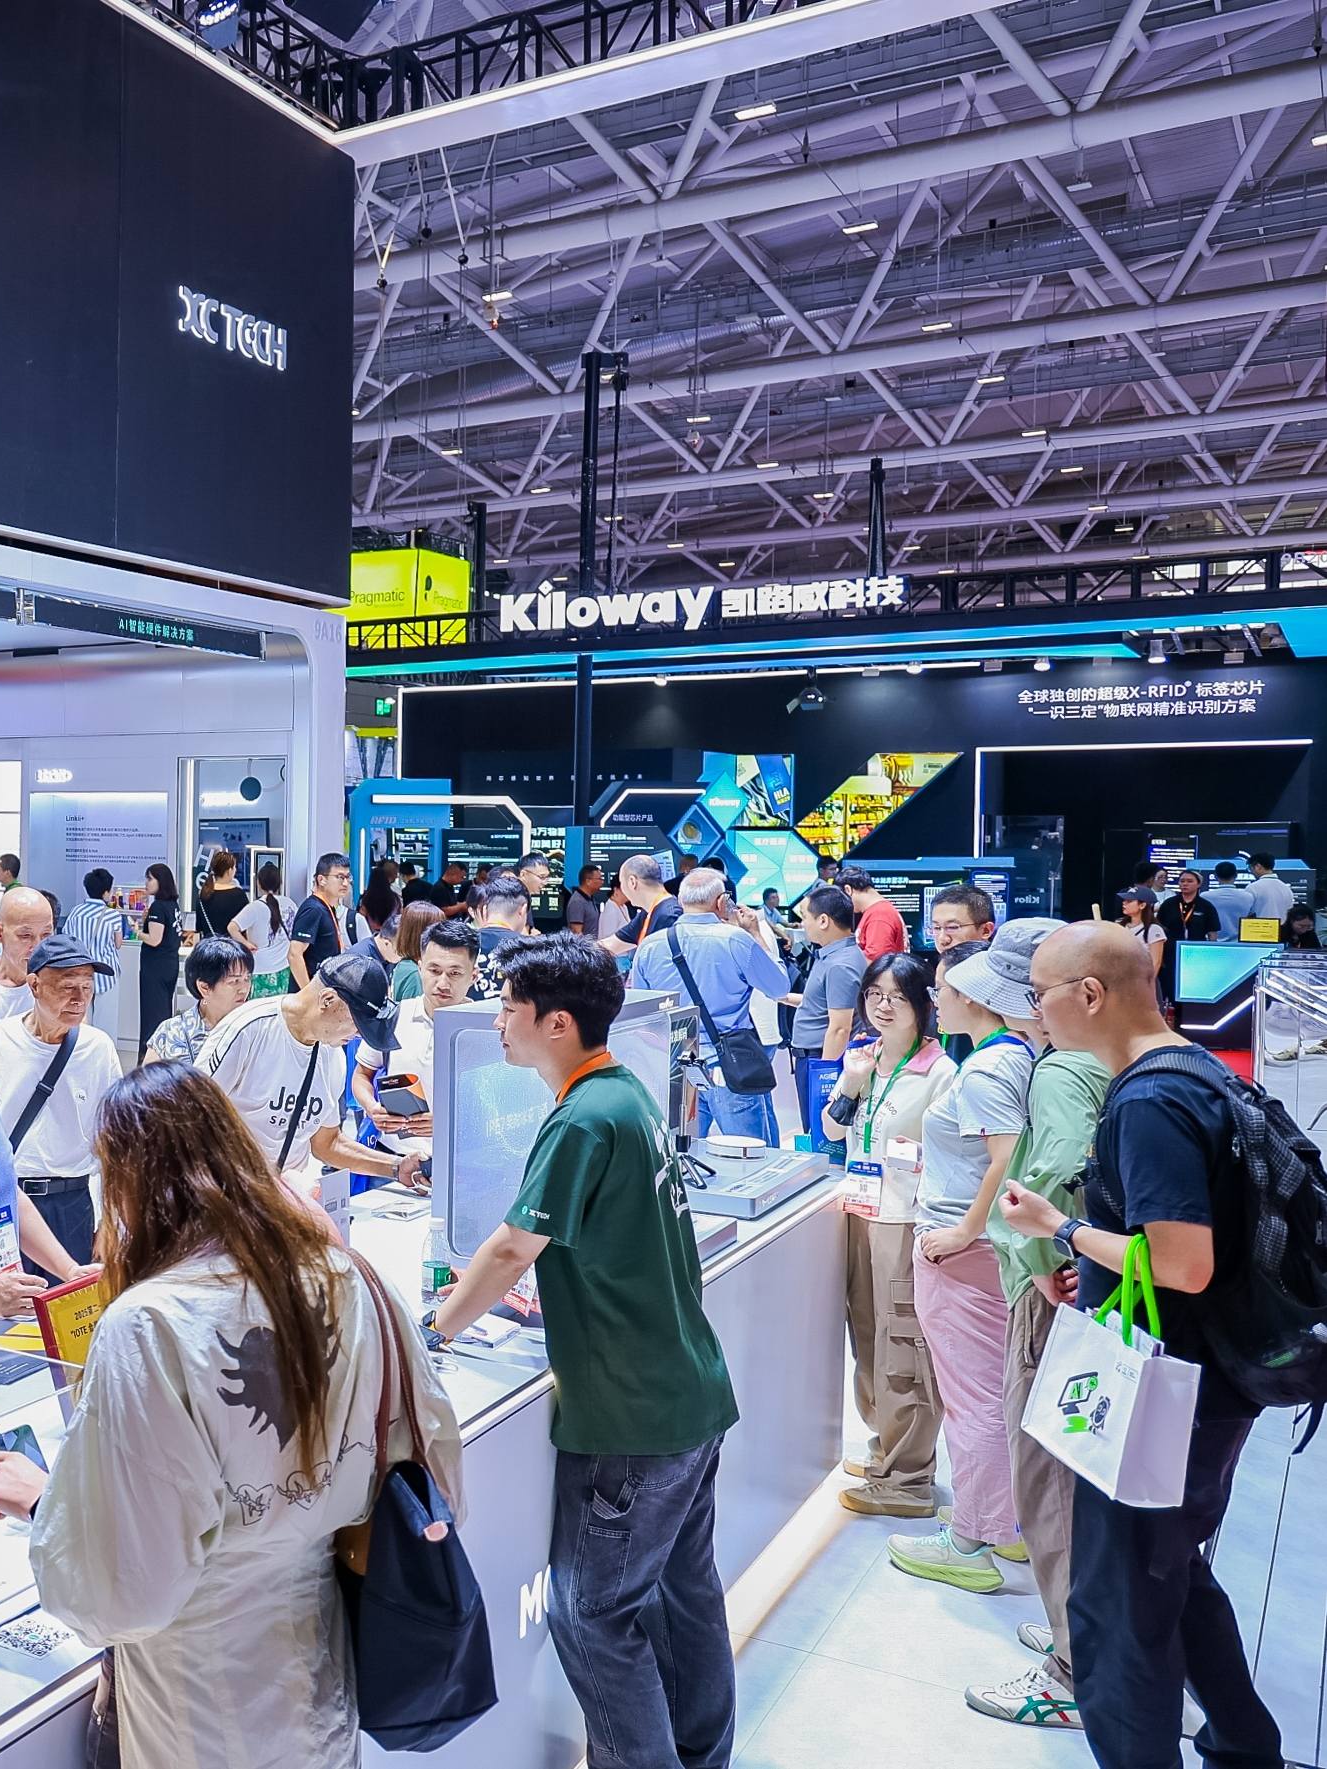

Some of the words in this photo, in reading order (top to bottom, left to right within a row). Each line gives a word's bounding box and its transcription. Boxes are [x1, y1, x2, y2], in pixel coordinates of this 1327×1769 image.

[178, 285, 219, 344] XC
[220, 303, 288, 371] TECH
[350, 589, 406, 606] Pragmatic
[499, 579, 715, 632] Kiloway
[720, 575, 906, 618] 凯路威科技
[117, 617, 195, 642] AI智能硬件解决方案
[313, 619, 343, 642] 9A16
[268, 1086, 323, 1122] Jep
